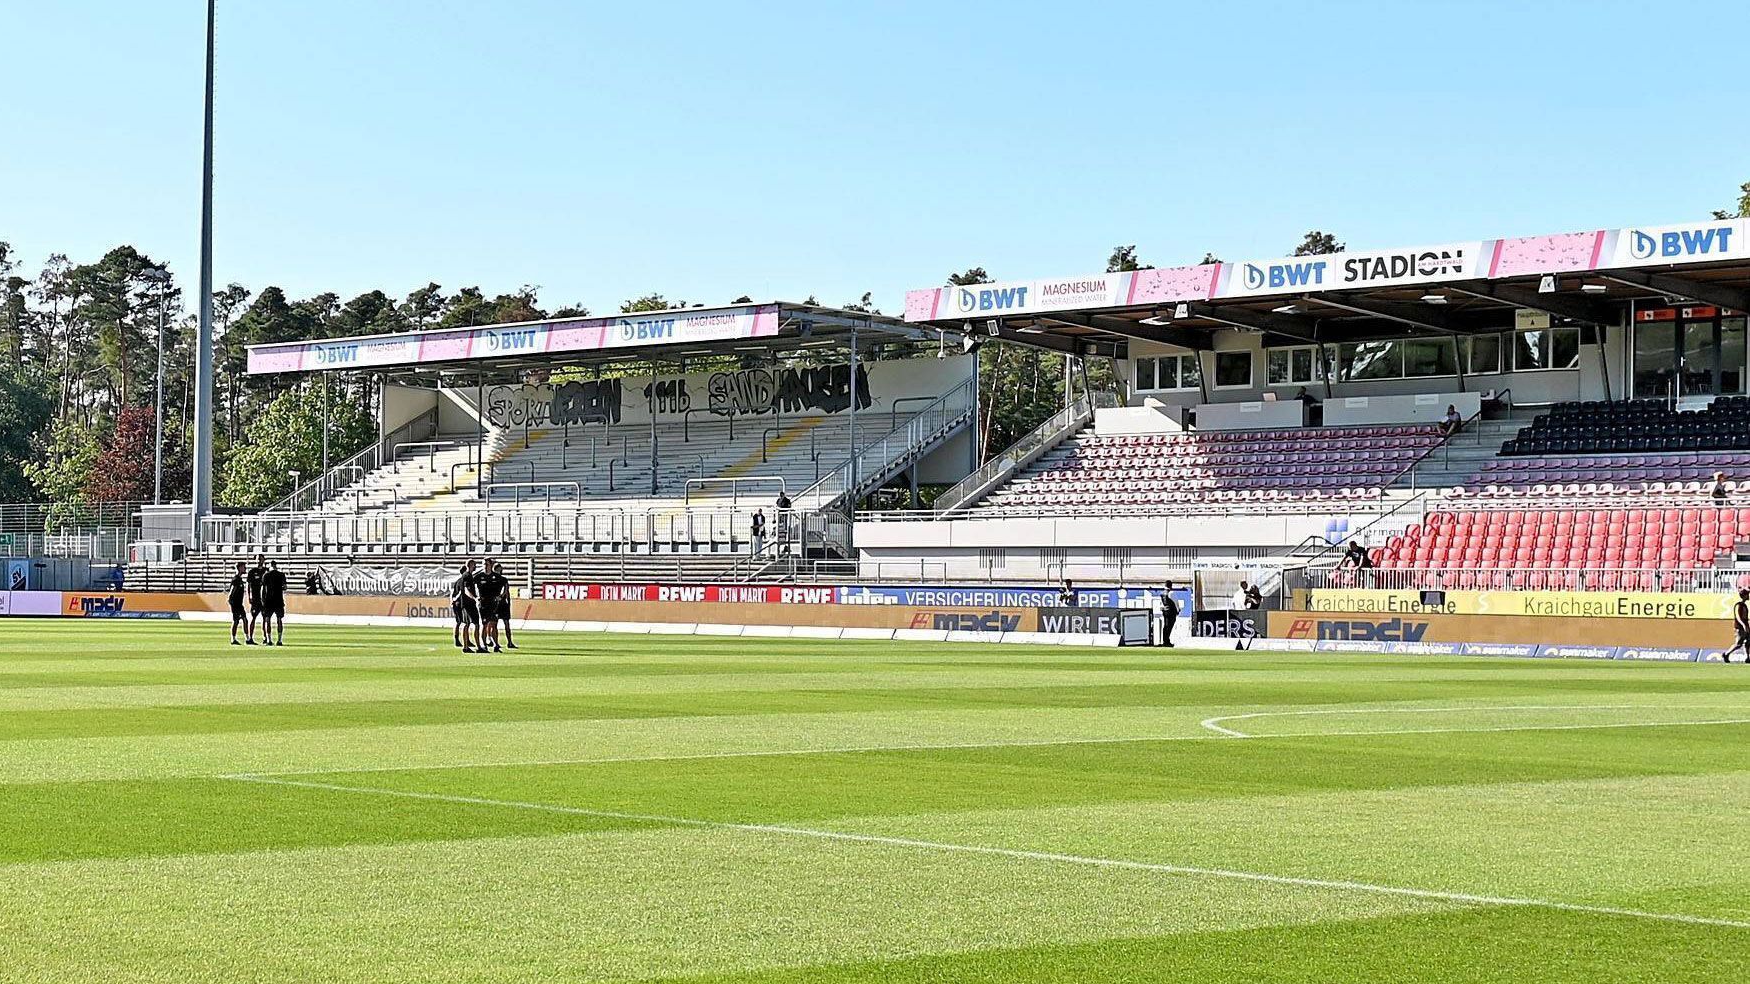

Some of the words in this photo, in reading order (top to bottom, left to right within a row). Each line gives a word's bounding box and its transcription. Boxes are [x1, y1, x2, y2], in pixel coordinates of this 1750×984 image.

[1661, 227, 1733, 257] BWT
[1268, 261, 1327, 288] BWT
[1344, 249, 1463, 282] STADION
[1042, 280, 1107, 296] MAGNESIUM
[979, 286, 1028, 310] BWT
[636, 318, 675, 340] BWT
[686, 314, 736, 328] MAGNESIUM
[501, 330, 536, 350] BWT
[327, 345, 358, 363] BWT
[708, 363, 872, 416] SANDHAUSEN
[545, 585, 590, 601] REWE
[620, 586, 647, 601] MARKT
[658, 585, 705, 602] REWE
[740, 587, 768, 603] MARKT
[780, 587, 832, 604] REWE
[905, 591, 1110, 608] VERSICHERUNGSGPPE
[1524, 596, 1695, 619] KraichgauEnergie
[1042, 616, 1090, 634] WIR!
